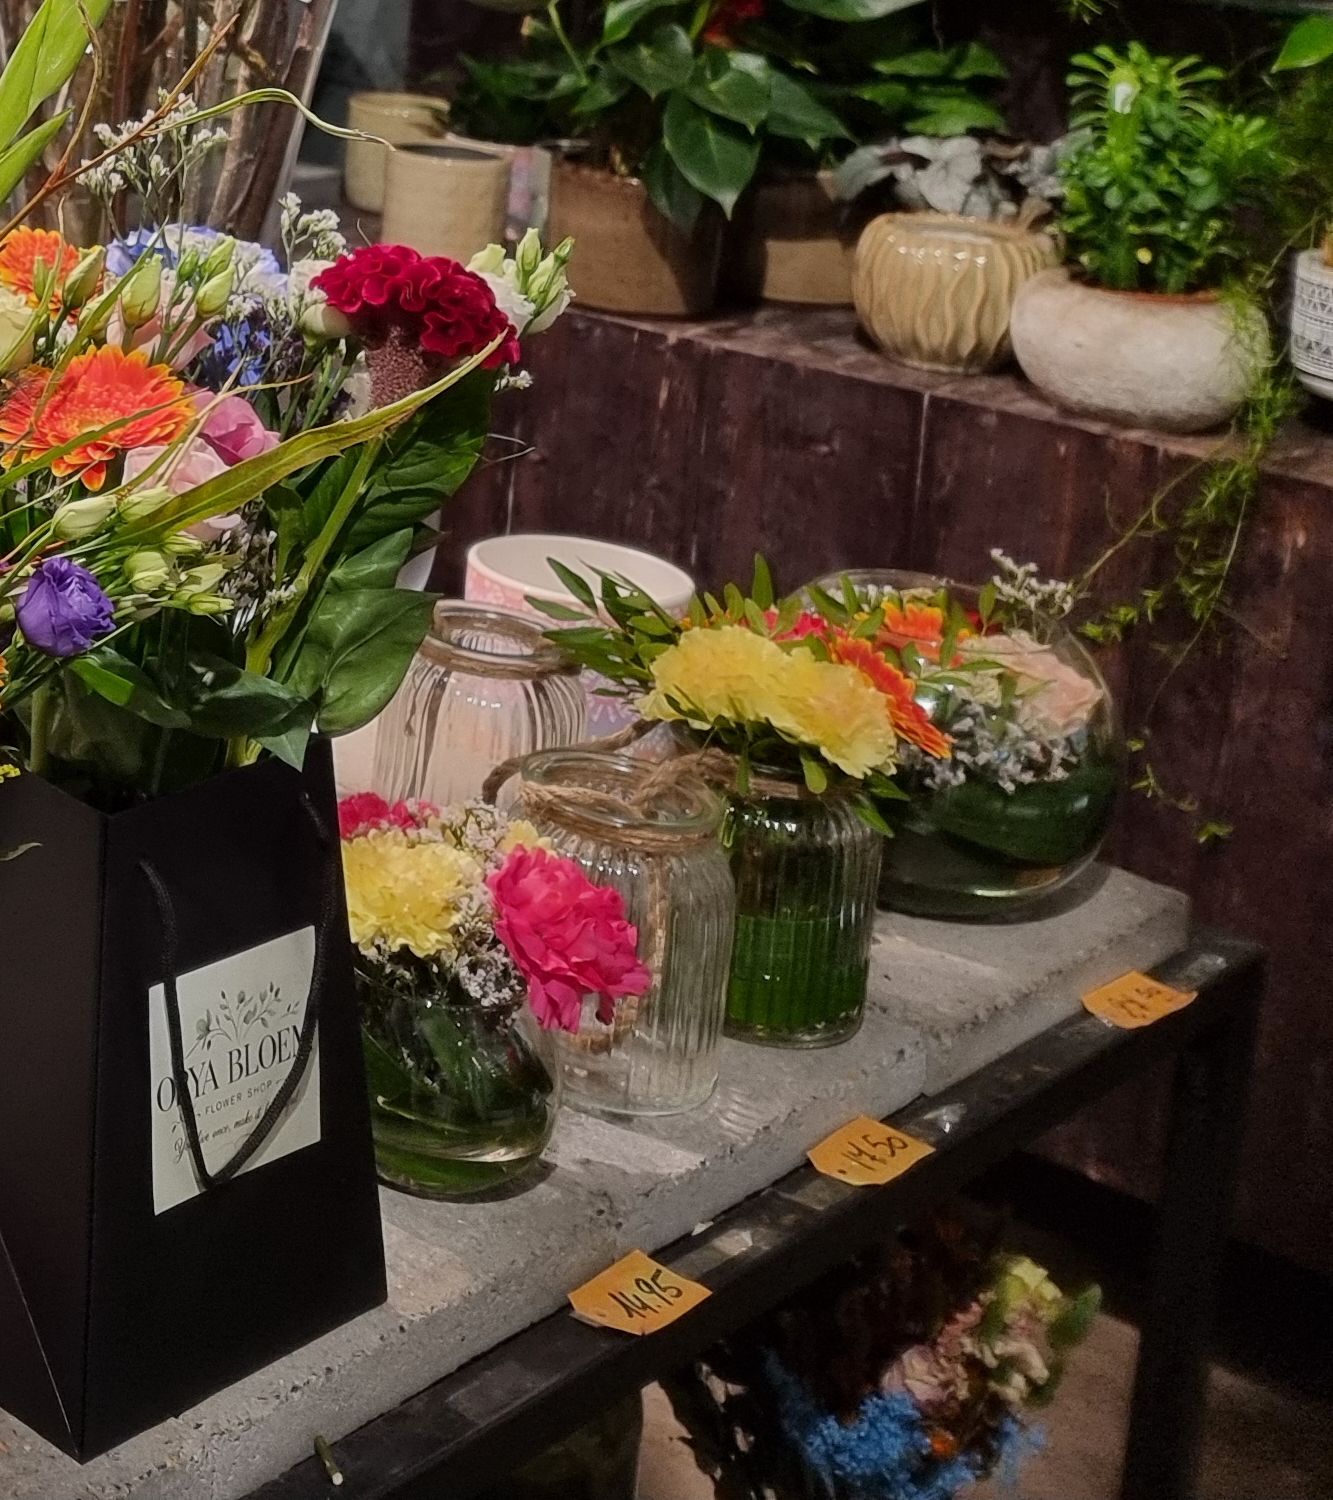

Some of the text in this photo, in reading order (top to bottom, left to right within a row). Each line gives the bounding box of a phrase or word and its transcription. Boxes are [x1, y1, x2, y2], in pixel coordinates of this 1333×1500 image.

[156, 1059, 220, 1112] OYA
[204, 1092, 242, 1115] FLOWER
[247, 1080, 273, 1099] SHOP
[607, 1268, 683, 1319] 14.95
